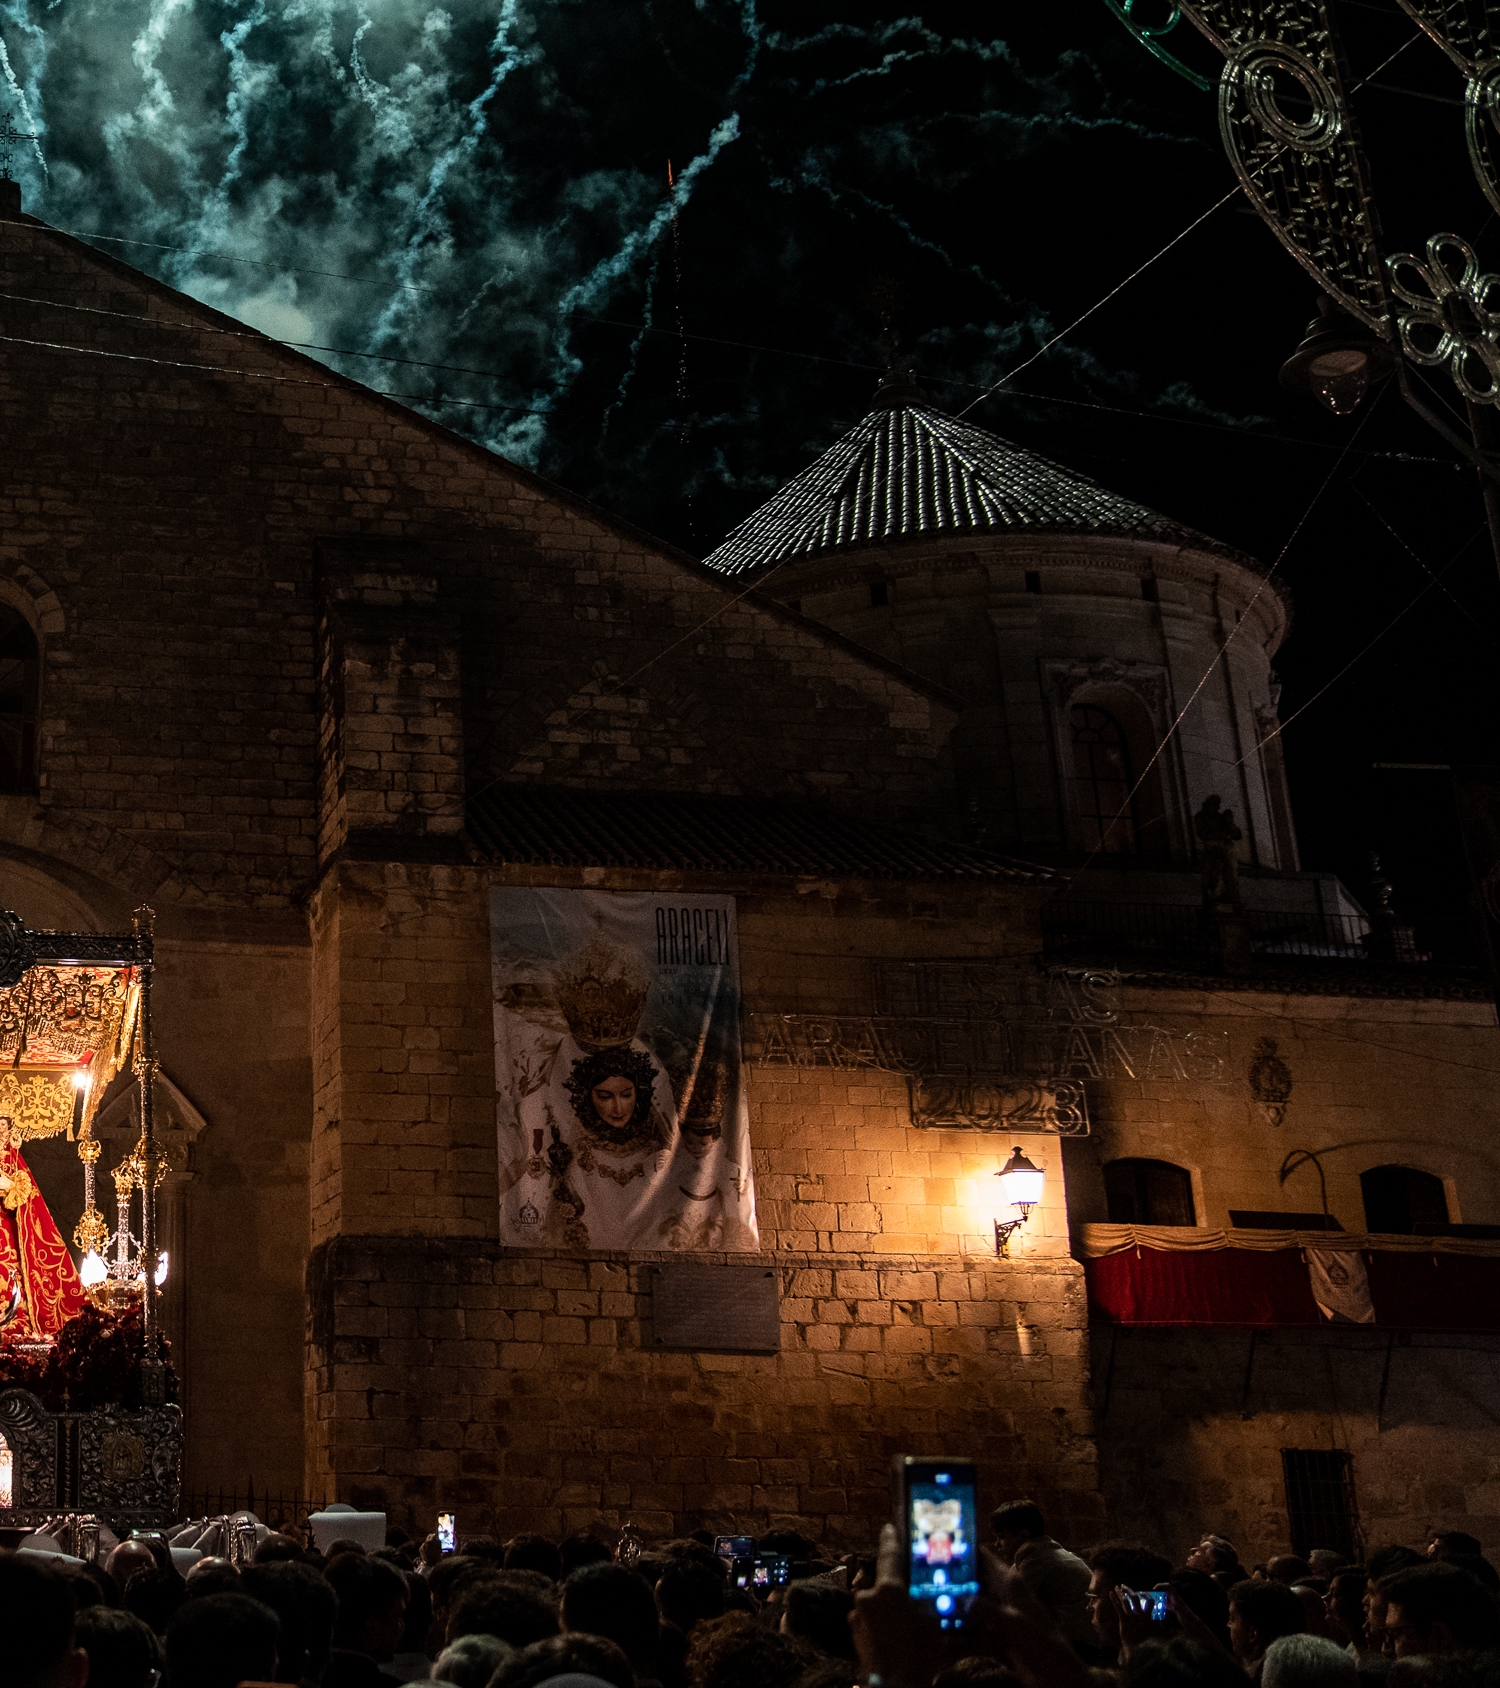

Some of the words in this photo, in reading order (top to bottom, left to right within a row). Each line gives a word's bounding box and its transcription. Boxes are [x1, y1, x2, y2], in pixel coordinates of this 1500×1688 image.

[656, 907, 729, 966] ARACELI
[875, 964, 1117, 1022] FIESTAS
[918, 1081, 1083, 1134] 2023
